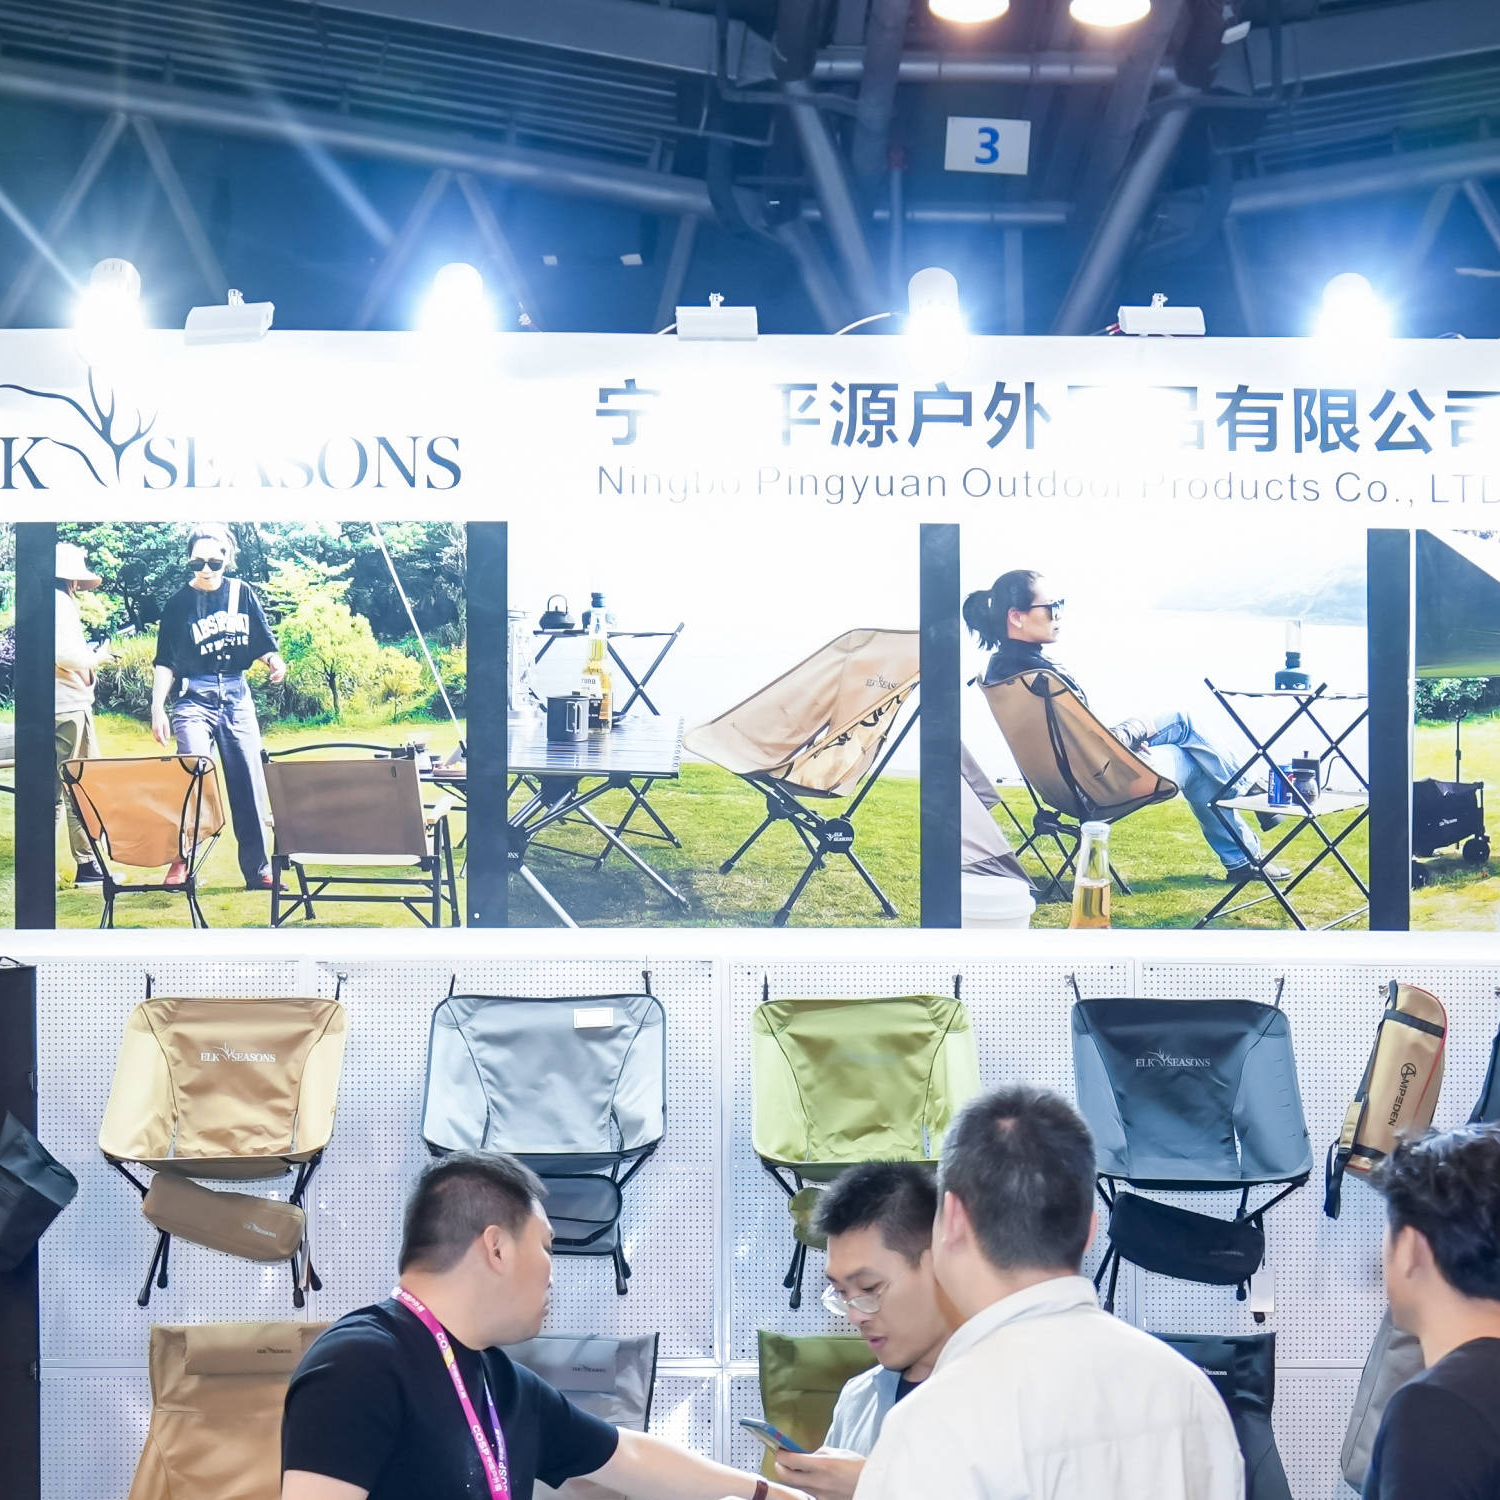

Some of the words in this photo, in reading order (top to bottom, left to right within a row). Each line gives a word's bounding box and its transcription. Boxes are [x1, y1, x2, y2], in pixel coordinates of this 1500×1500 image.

[974, 126, 1000, 165] 3
[757, 465, 947, 504] Pingyuan
[1142, 471, 1320, 503] Products
[1334, 471, 1415, 508] Co.,
[200, 1052, 220, 1062] ELK
[231, 1052, 277, 1063] SEASONS
[1135, 1058, 1155, 1068] ELK
[1166, 1058, 1211, 1067] SEASONS
[472, 1424, 490, 1456] COSP
